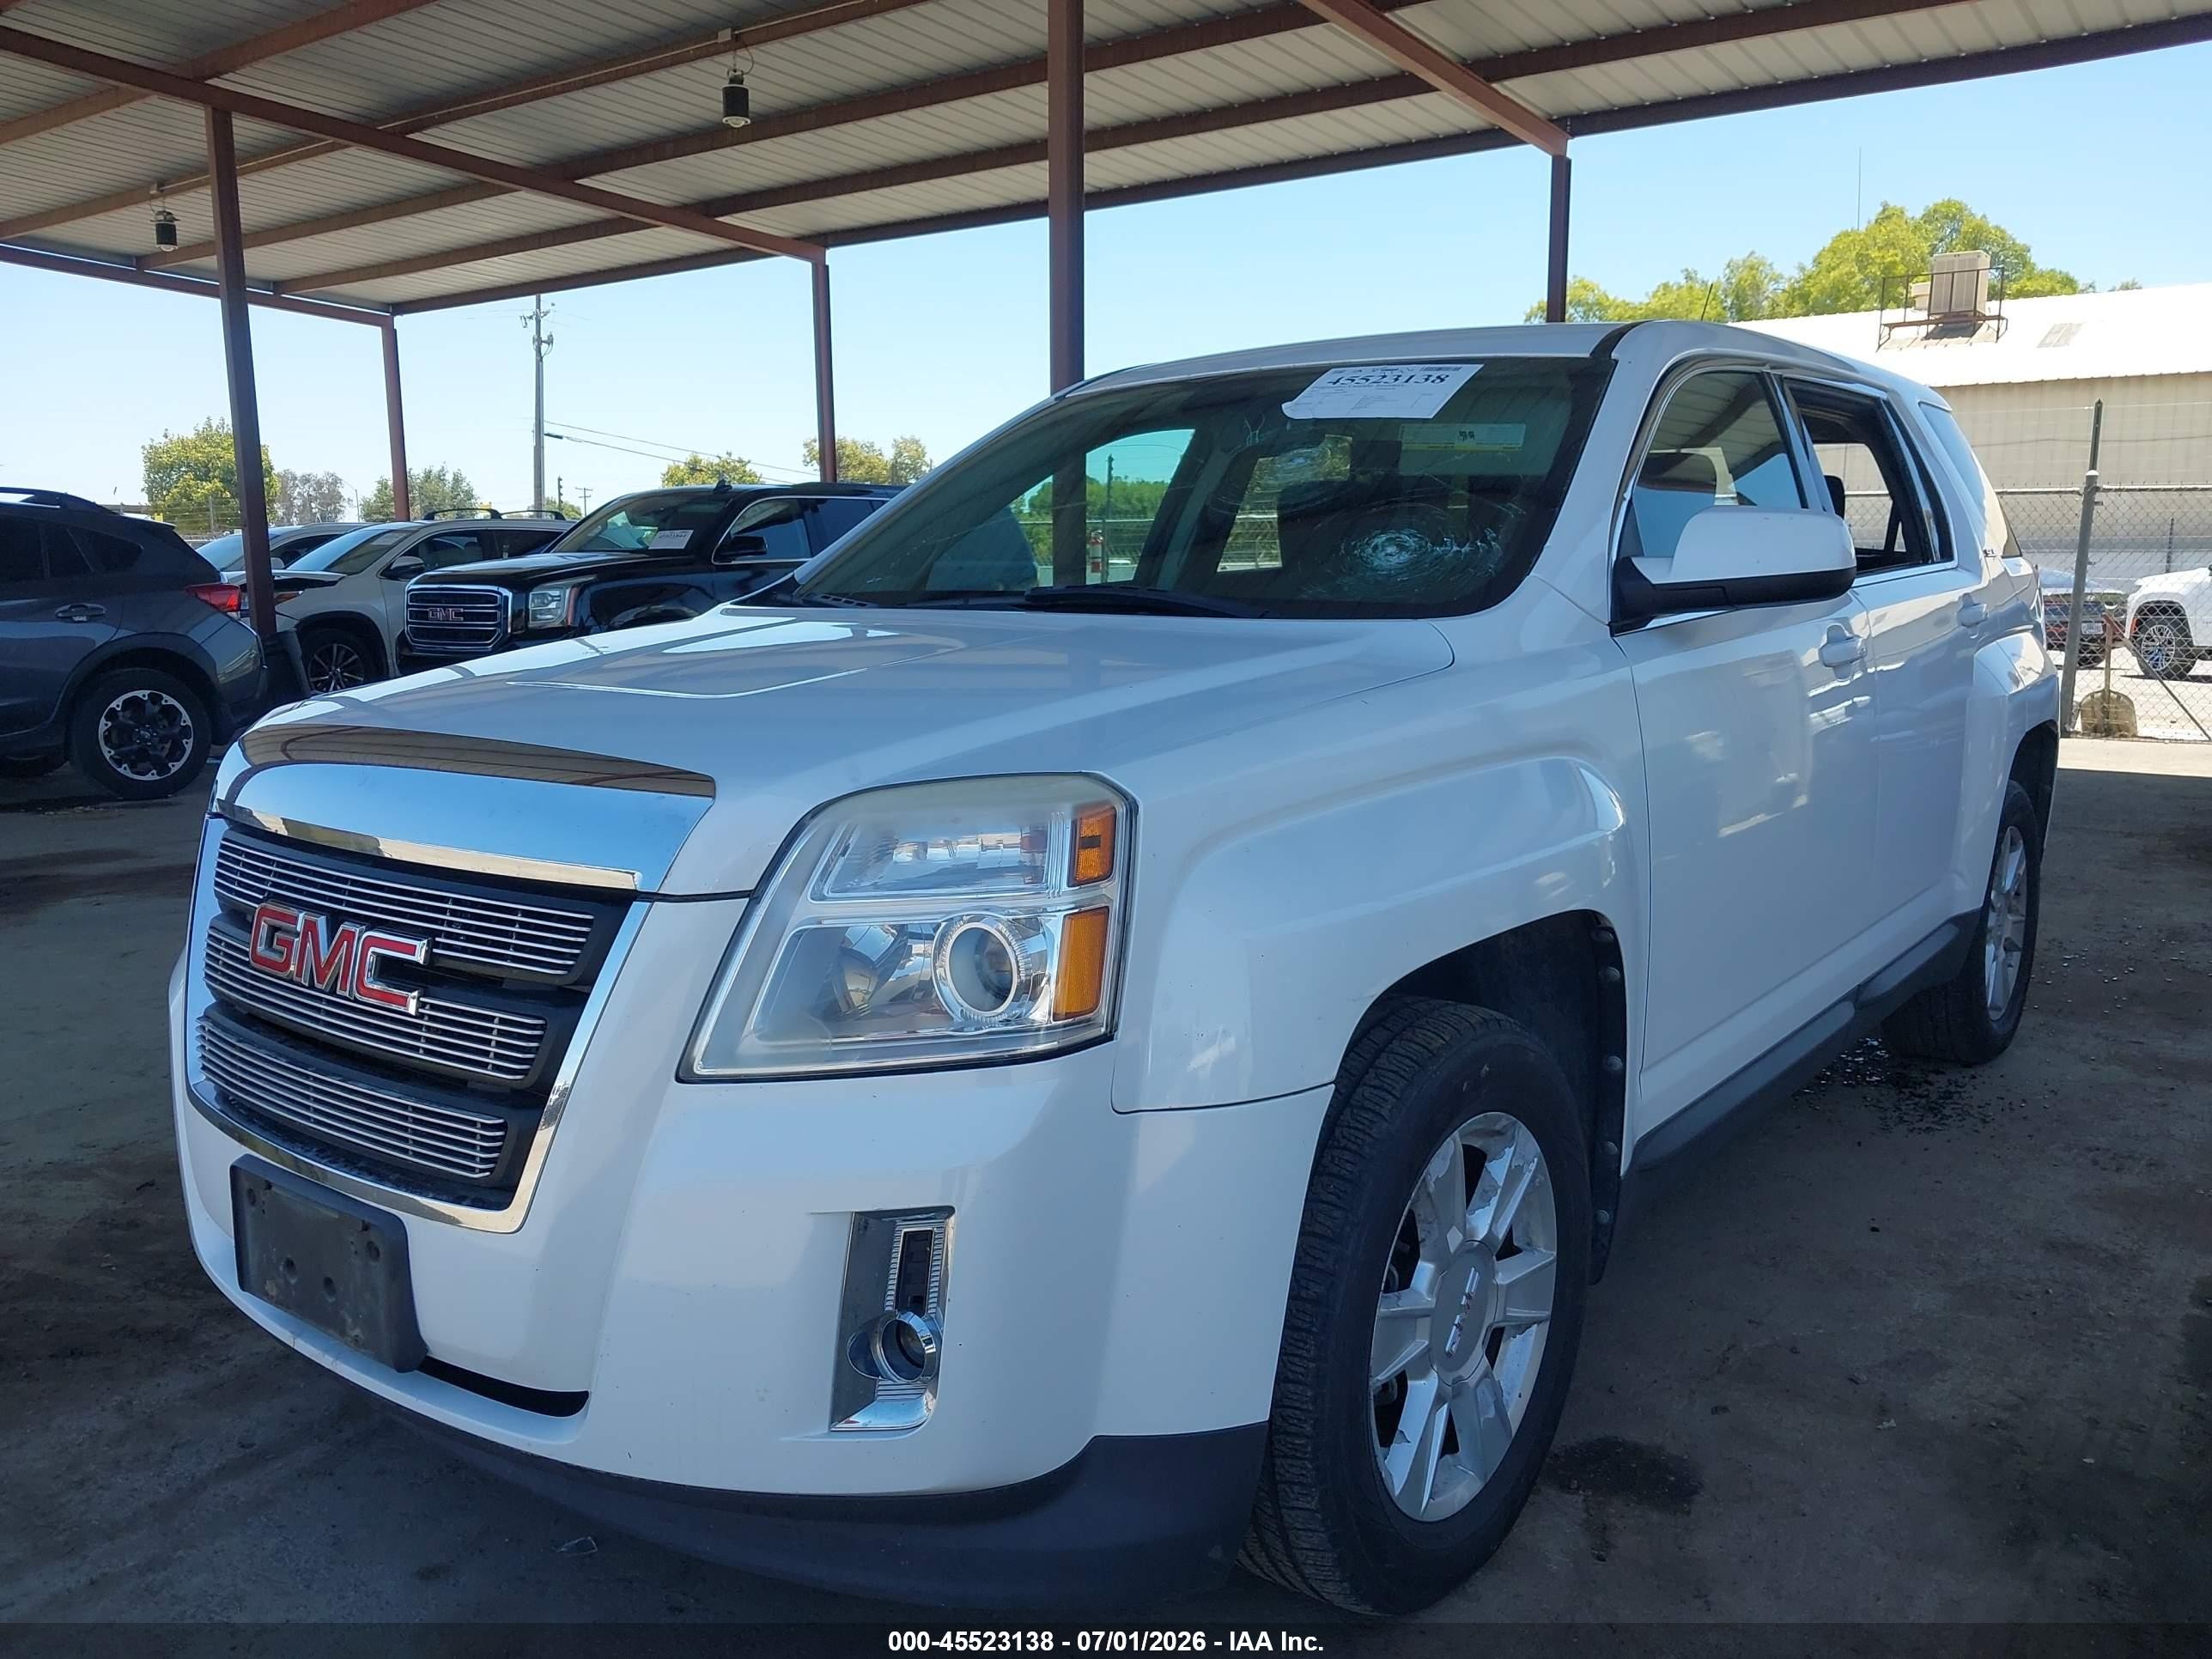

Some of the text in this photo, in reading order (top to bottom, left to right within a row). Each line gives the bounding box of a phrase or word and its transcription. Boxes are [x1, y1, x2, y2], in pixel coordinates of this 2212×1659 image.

[1326, 374, 1450, 386] 45523138
[428, 607, 465, 622] GMC
[249, 901, 428, 1016] GMC
